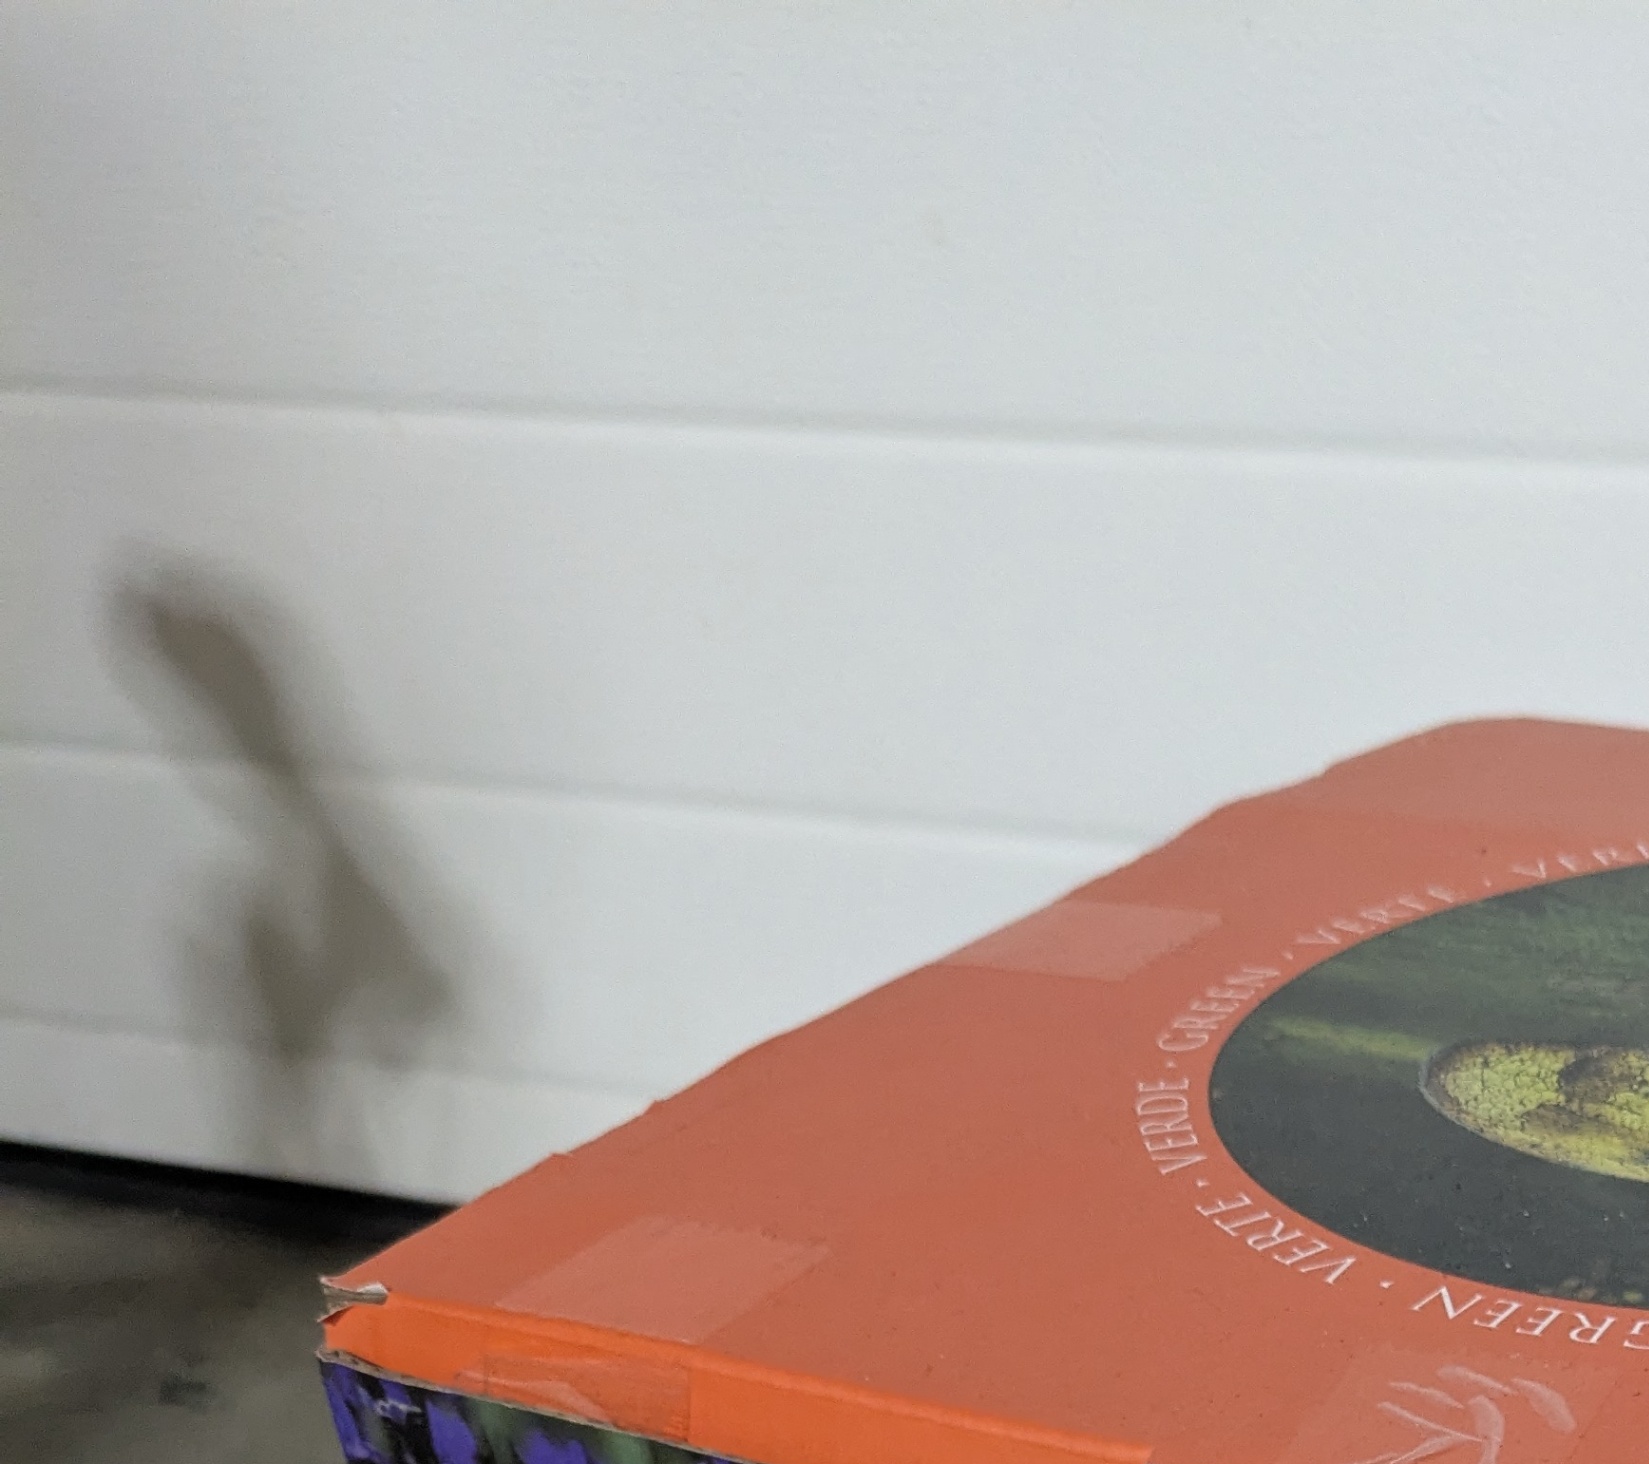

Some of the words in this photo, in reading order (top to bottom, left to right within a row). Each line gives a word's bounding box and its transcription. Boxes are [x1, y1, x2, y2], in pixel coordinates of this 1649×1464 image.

[1156, 963, 1281, 1054] GREEN
[1136, 1079, 1206, 1178] VERDE
[1193, 1191, 1358, 1287] VERTE
